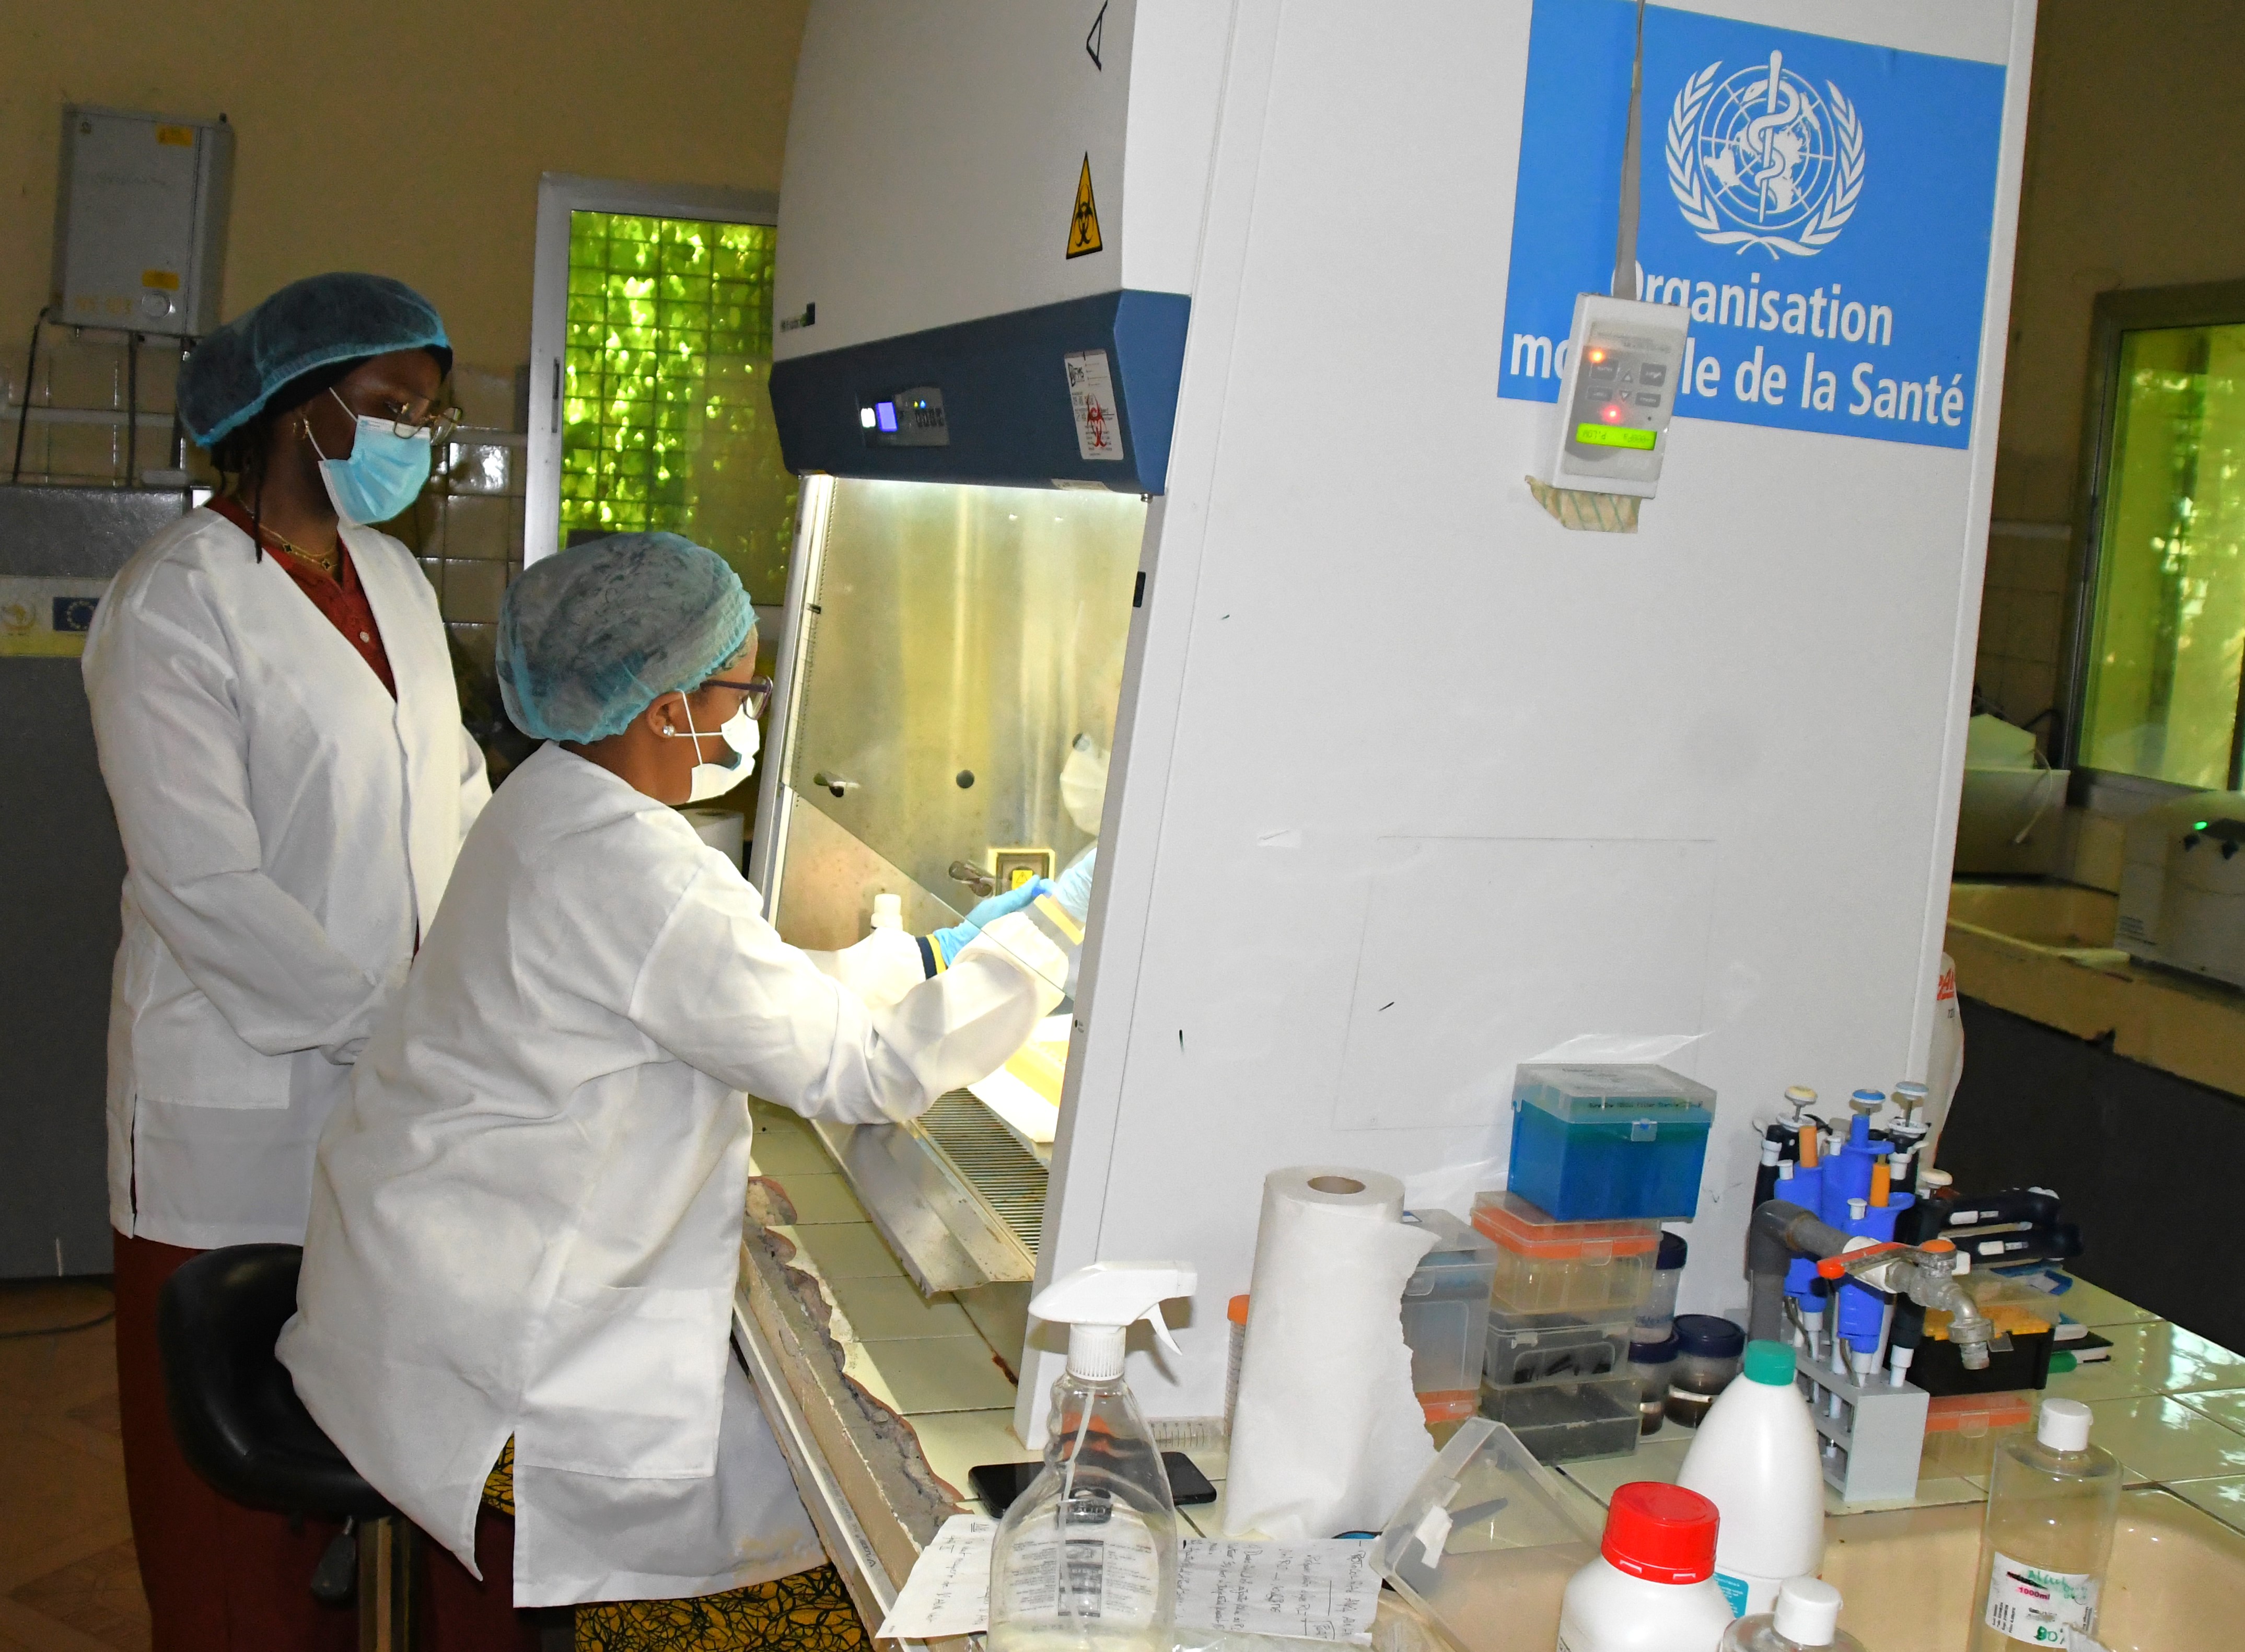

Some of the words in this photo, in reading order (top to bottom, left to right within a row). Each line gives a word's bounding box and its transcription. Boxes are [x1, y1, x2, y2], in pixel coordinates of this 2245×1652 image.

[1735, 345, 1787, 405] de
[1801, 352, 1837, 412] la
[1848, 362, 1964, 426] Santé
[2018, 1587, 2050, 1600] 1000ml
